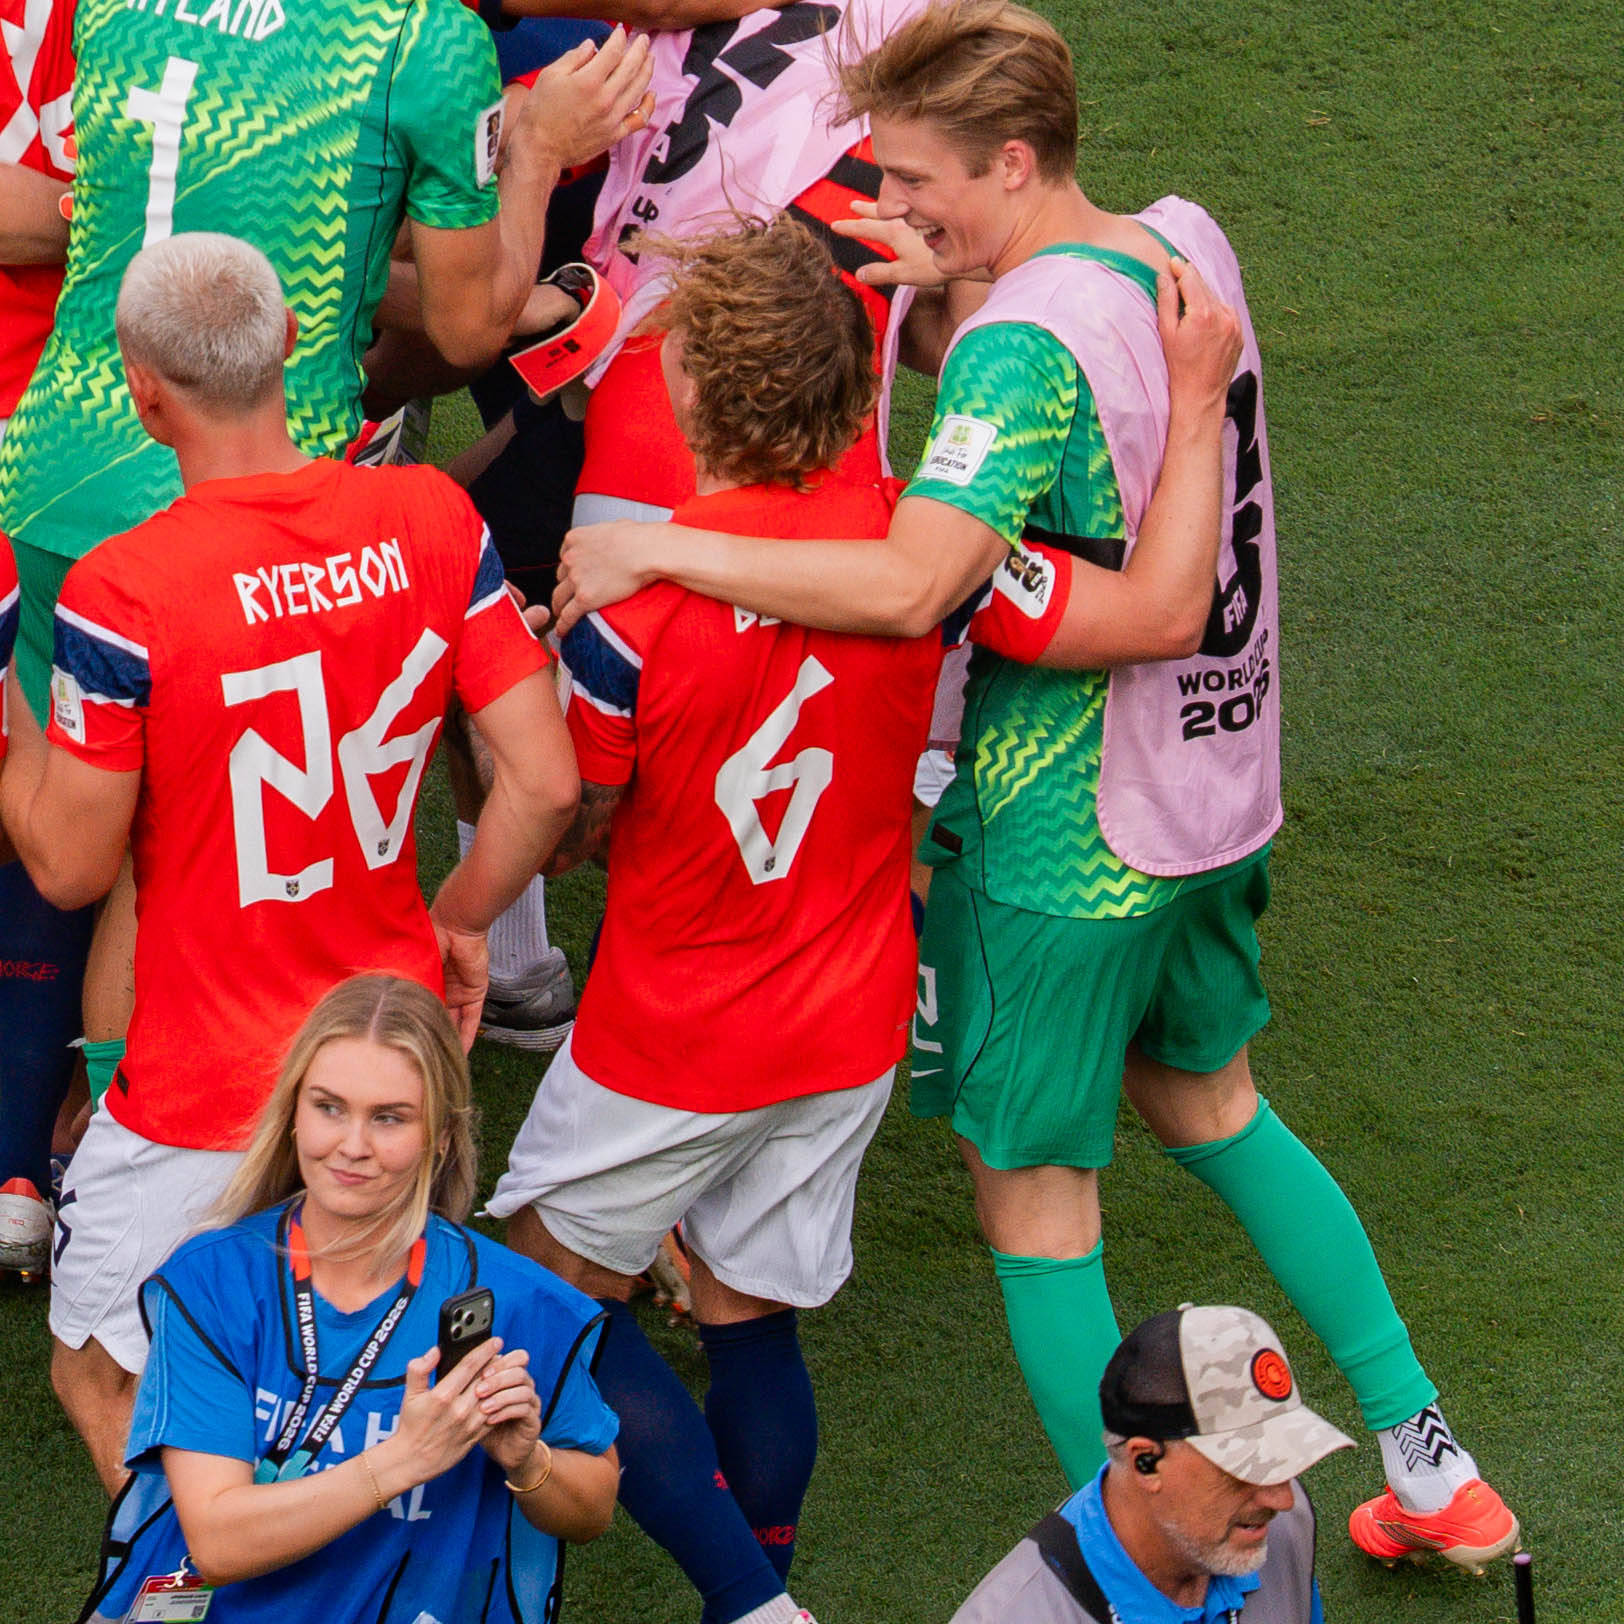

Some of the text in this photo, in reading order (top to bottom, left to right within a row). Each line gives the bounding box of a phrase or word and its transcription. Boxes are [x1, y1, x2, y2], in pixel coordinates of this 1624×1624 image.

[127, 56, 199, 250] 1
[632, 195, 659, 224] UP
[232, 537, 409, 625] RYERSON
[221, 627, 449, 909] 26
[714, 655, 833, 885] 6
[276, 1292, 318, 1452] FIFA WORLD CUP 2026
[313, 1296, 409, 1443] FIFA WORLD CUP 2026
